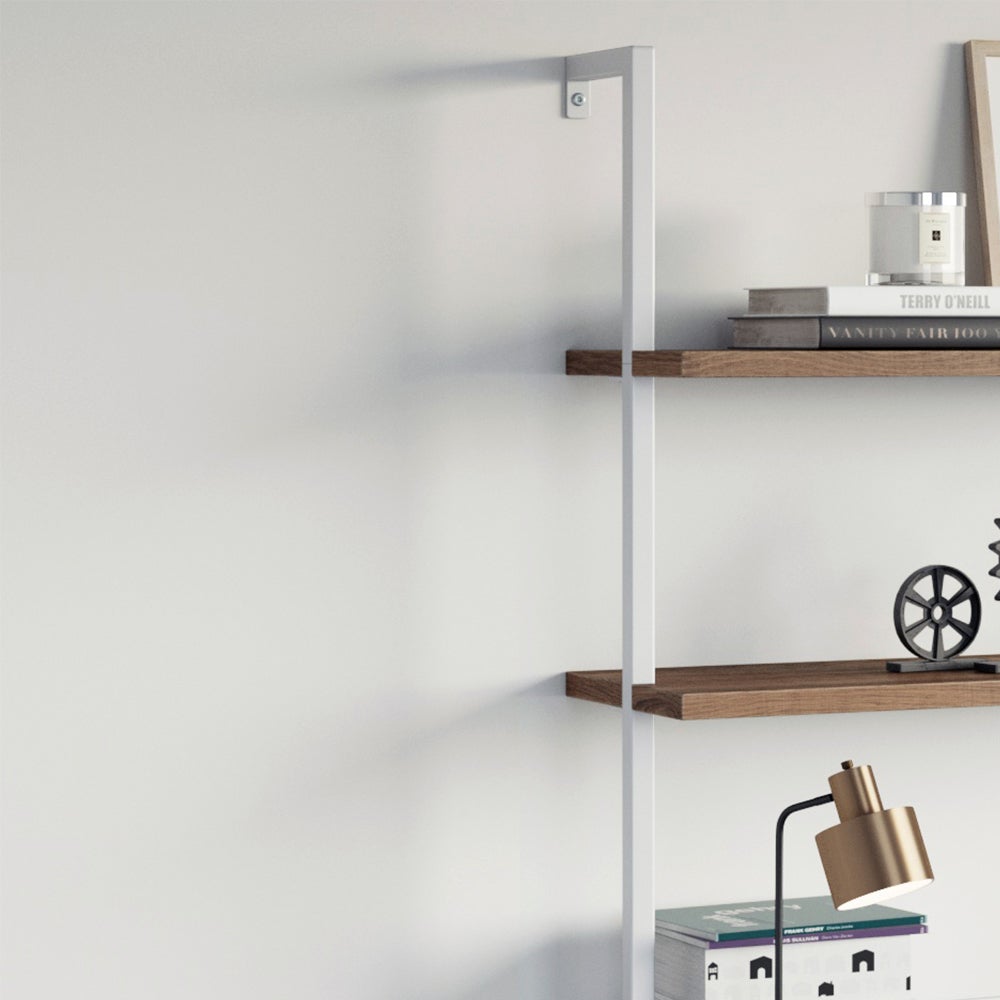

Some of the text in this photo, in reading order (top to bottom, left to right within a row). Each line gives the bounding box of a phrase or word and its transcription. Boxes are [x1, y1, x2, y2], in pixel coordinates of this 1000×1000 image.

[899, 294, 991, 309] TERRY O'NEILL
[827, 327, 897, 339] VANITY
[905, 327, 949, 339] FAIR
